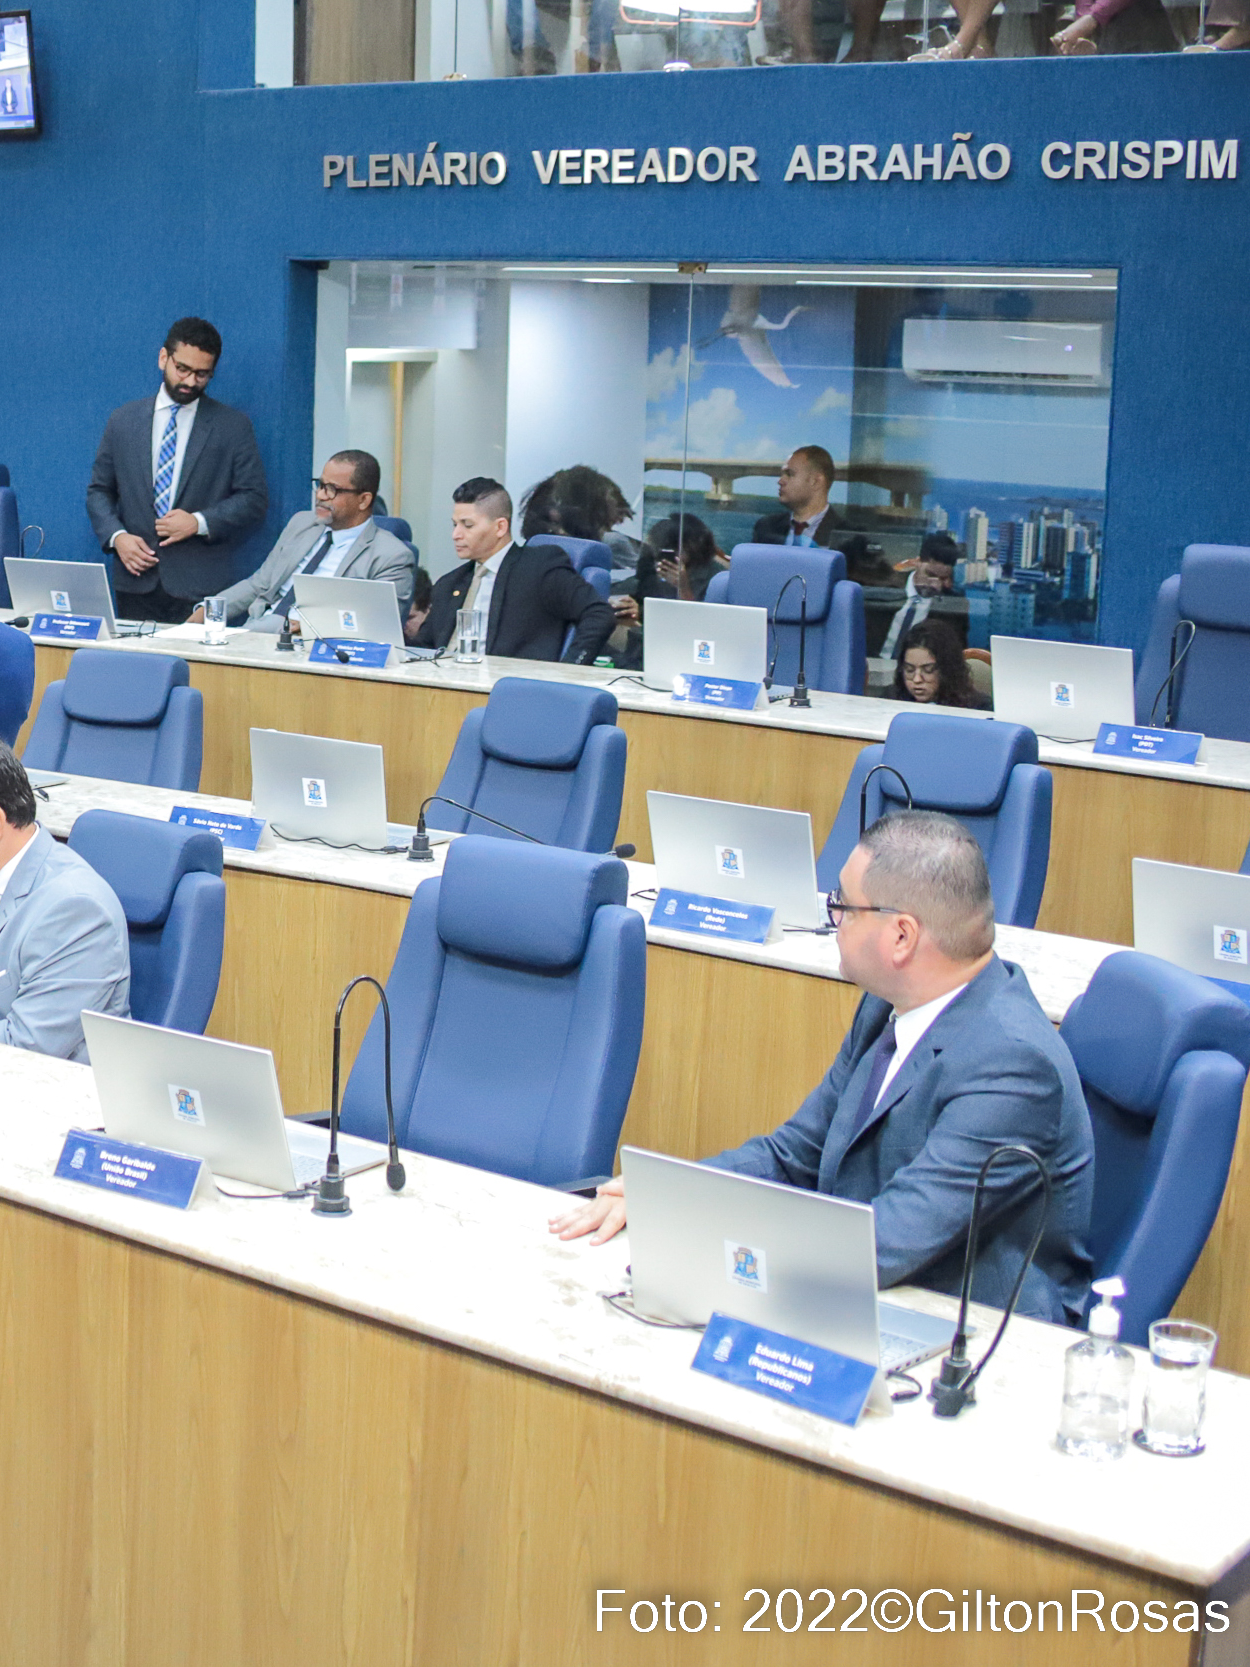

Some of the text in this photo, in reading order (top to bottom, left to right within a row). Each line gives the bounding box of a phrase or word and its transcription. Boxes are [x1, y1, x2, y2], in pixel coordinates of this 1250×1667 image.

[322, 132, 1239, 189] PLENÁRIO VEREADOR ABRAHÃO CRISPIM
[1138, 740, 1154, 748] (PDT)
[1143, 735, 1164, 743] Silveira
[1131, 746, 1157, 755] Vereador
[687, 903, 749, 920] Ricardo Vasconcelos
[705, 914, 726, 925] (Rede)
[699, 921, 727, 932] Vereador
[100, 1151, 157, 1172] Breno Garibalde
[101, 1161, 149, 1182] (União Brasil)
[105, 1173, 137, 1189] Vereador
[755, 1343, 815, 1373] Eduardo Lima
[748, 1355, 812, 1386] (Republicanos)
[755, 1368, 796, 1393] Vereador
